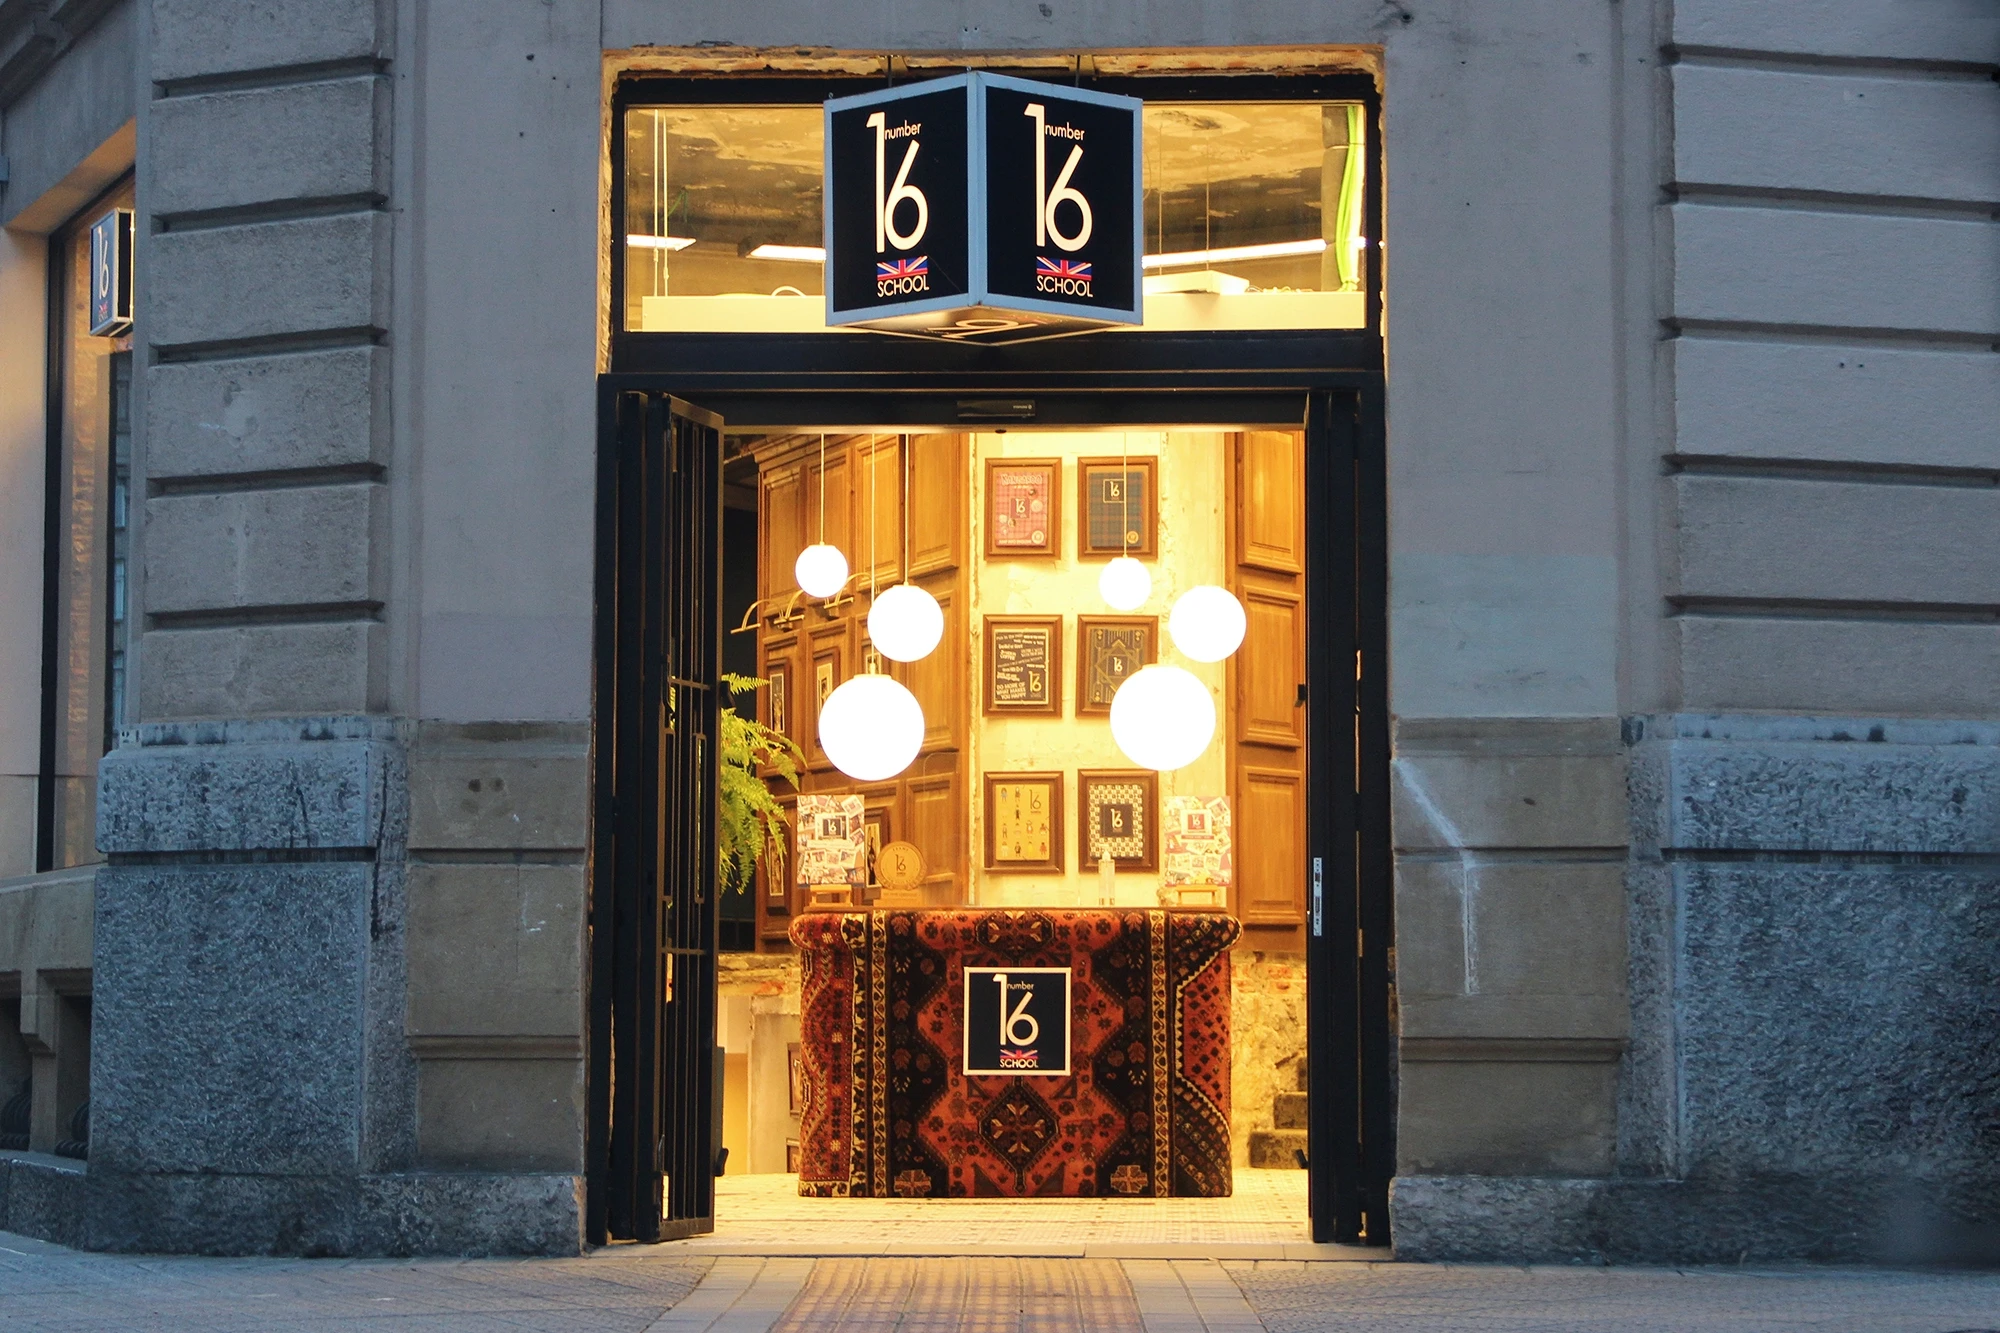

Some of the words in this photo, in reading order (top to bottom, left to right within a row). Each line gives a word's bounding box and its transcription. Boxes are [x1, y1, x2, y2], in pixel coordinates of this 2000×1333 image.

[884, 119, 922, 141] number
[1045, 120, 1085, 141] number
[866, 111, 928, 254] 16
[1024, 102, 1093, 252] 16
[876, 273, 930, 298] SCHOOL
[1036, 274, 1093, 298] SCHOOL
[1028, 670, 1042, 693] 16
[1029, 788, 1042, 810] 16
[1110, 808, 1123, 828] 16
[1006, 980, 1035, 990] number
[992, 973, 1039, 1047] 16
[999, 1058, 1039, 1069] SCHOOL
